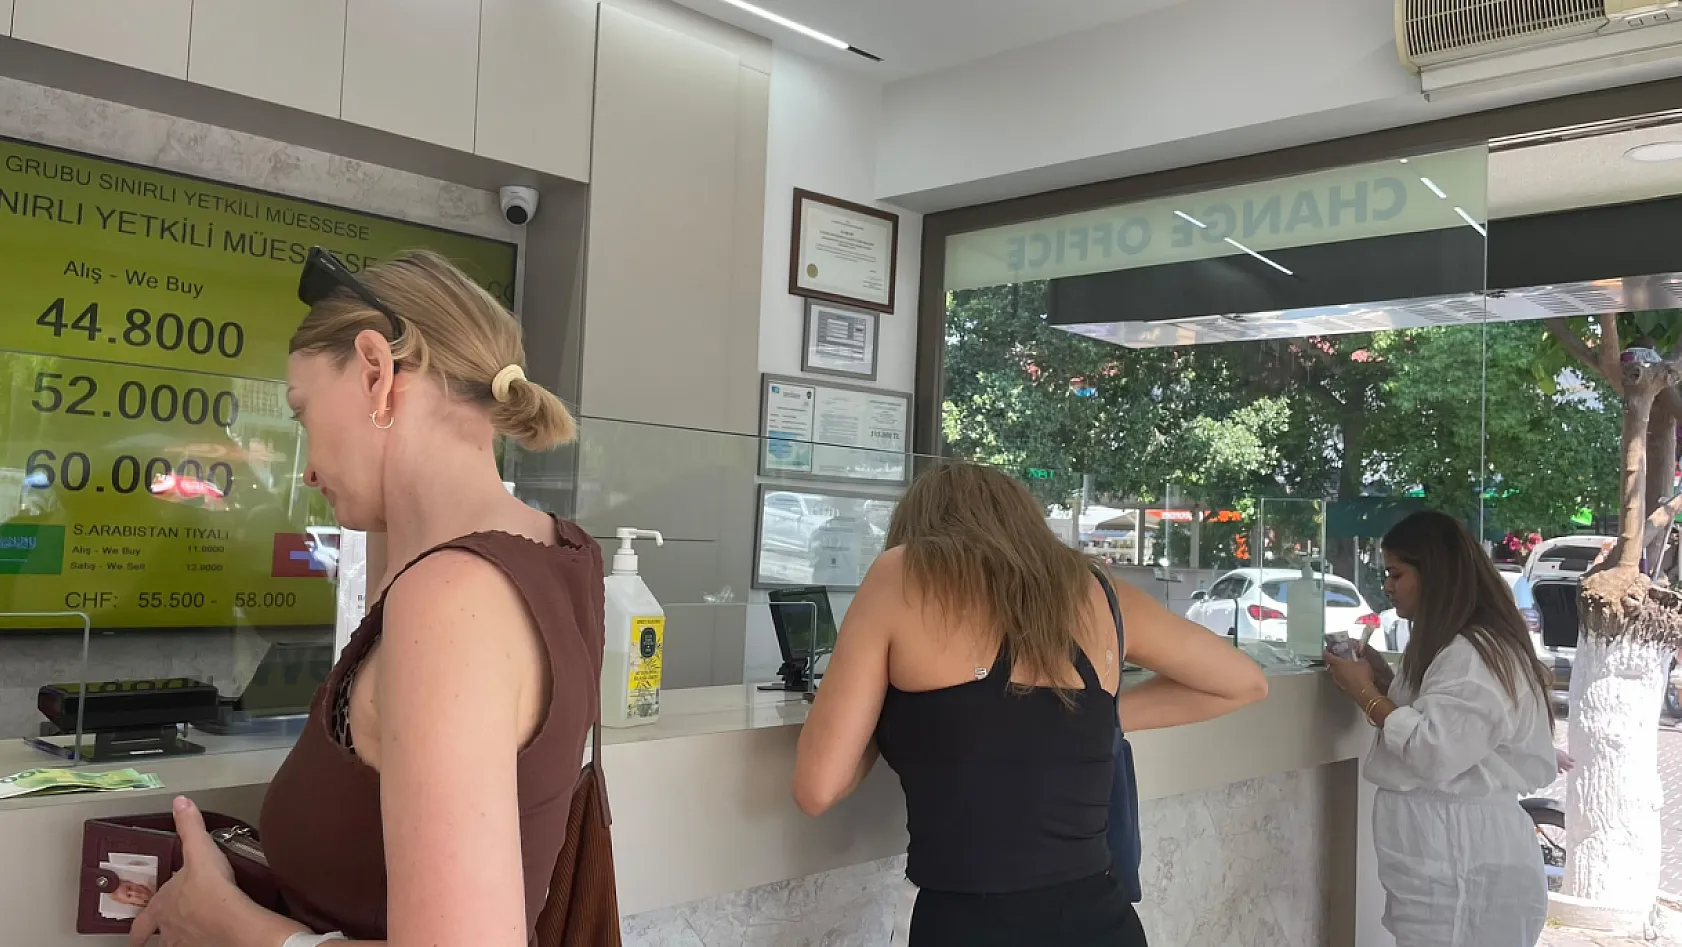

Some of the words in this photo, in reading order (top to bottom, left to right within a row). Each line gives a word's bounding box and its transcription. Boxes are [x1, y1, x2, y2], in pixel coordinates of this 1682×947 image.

[5, 155, 91, 186] GRUBU
[99, 173, 177, 203] SINIRLI
[183, 189, 260, 219] YETKİLİ
[266, 206, 370, 241] MÜESSESE
[96, 205, 213, 249] YETKİLİ
[64, 259, 102, 284] Alış
[125, 269, 158, 290] We
[166, 272, 204, 298] Buy
[36, 297, 244, 358] 44.8000
[31, 372, 239, 429] 52.0000
[64, 591, 119, 609] CHF:
[138, 591, 205, 609] 55.500
[234, 591, 297, 609] 58.000
